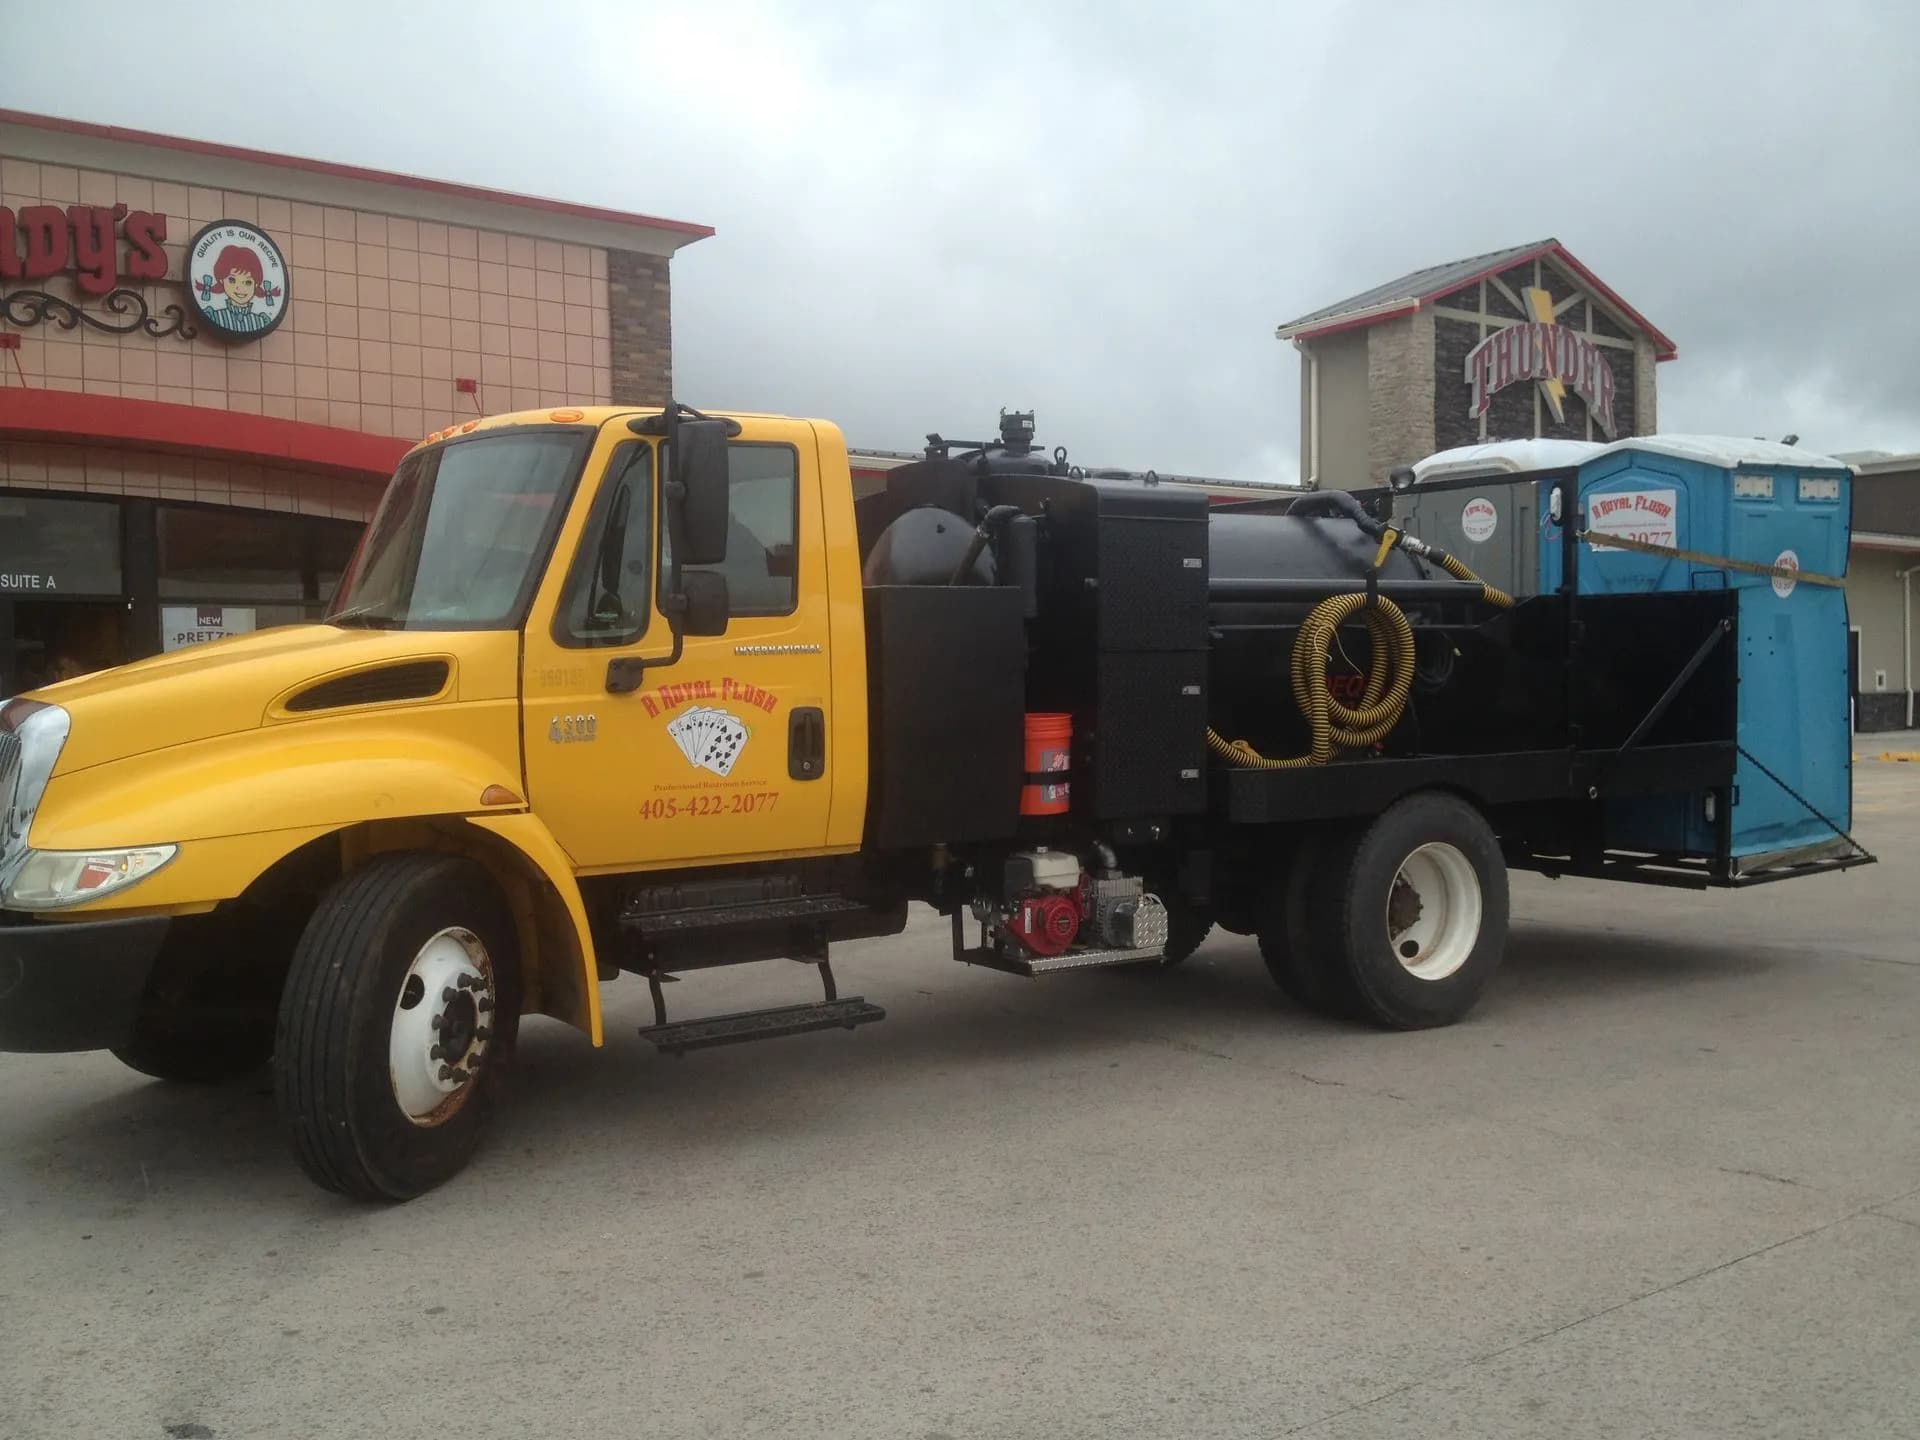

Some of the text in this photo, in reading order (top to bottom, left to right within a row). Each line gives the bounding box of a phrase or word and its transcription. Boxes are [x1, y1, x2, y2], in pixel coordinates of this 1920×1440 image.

[197, 229, 279, 268] QUALITY IS OUR RECIPE
[1465, 322, 1617, 440] THUNDER
[1600, 497, 1632, 515] ROYAL
[1635, 495, 1671, 518] FLUSH
[0, 574, 56, 589] SUITE A
[199, 616, 221, 625] NEW
[176, 631, 240, 644] PRETZ
[640, 677, 779, 719] A ROYAL FLUSH
[639, 792, 779, 820] 405-422-2077
